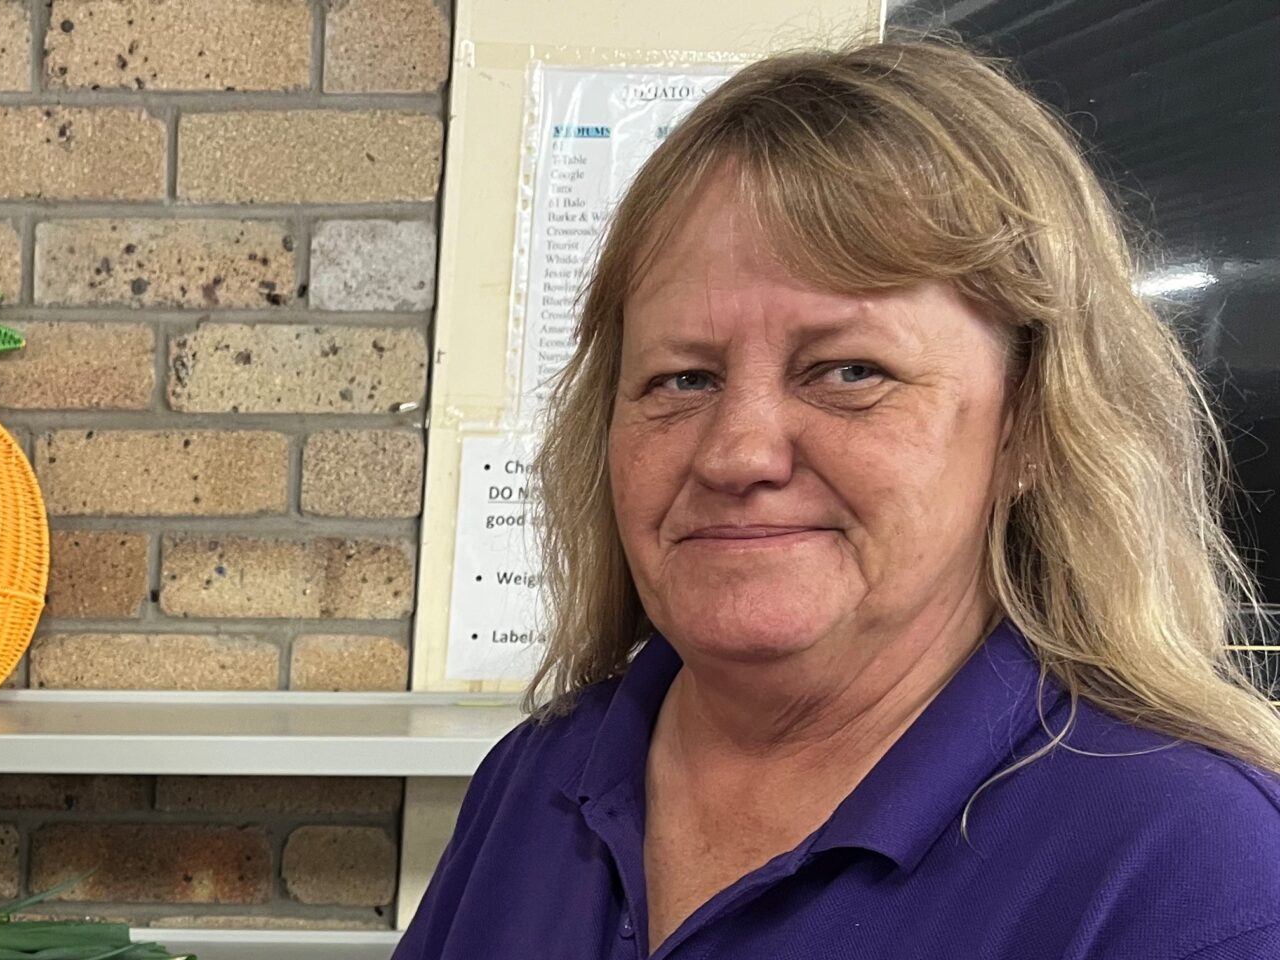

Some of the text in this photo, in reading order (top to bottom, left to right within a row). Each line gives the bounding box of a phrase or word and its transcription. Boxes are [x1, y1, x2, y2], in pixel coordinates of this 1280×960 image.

[489, 486, 513, 500] DO
[486, 515, 524, 529] good
[492, 630, 533, 643] Label
